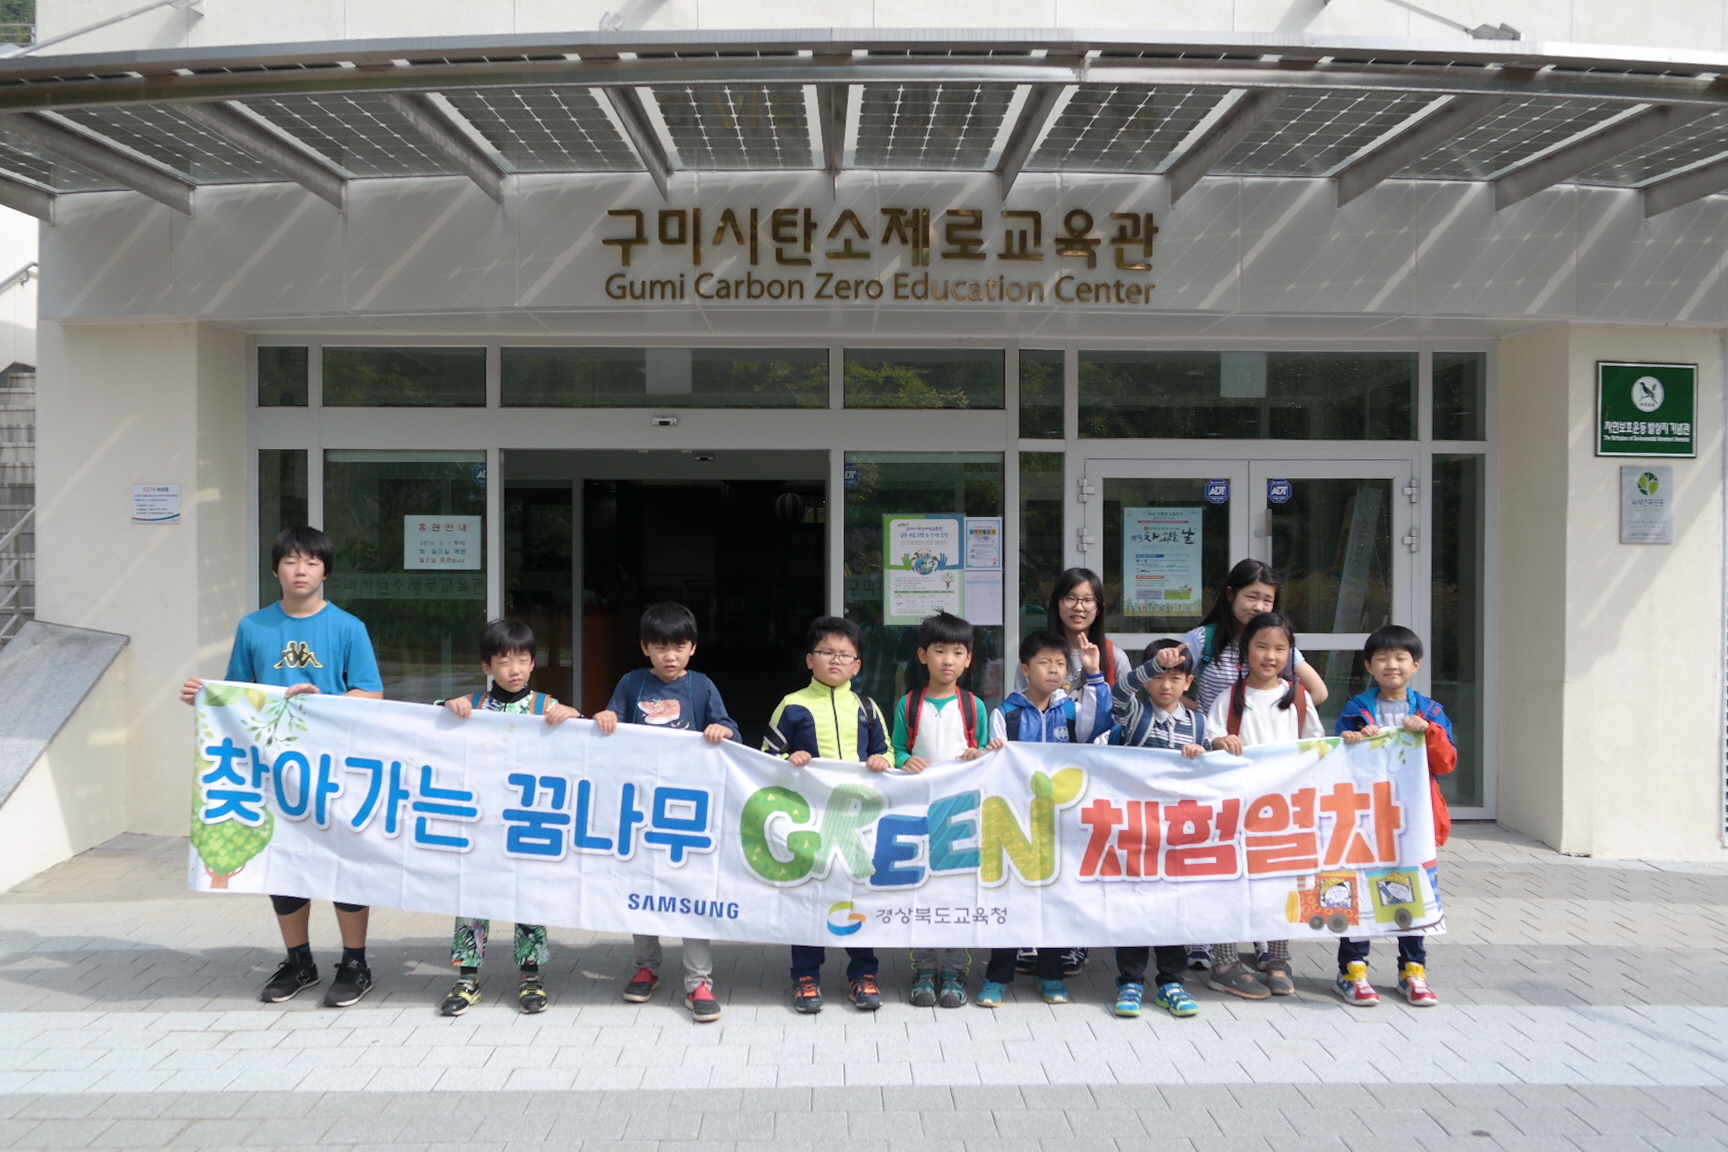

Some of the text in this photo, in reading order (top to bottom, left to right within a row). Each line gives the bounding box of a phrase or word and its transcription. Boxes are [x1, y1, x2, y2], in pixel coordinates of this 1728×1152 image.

[601, 207, 1159, 271] 구미시탄소제로교육관
[604, 271, 1156, 304] Gumi Carbon Zero Education Center
[1208, 486, 1226, 496] ADT
[1270, 486, 1288, 496] ADT
[202, 737, 713, 862] 찾아가는 꿈나무
[741, 770, 1070, 887] GREEN
[1079, 780, 1402, 877] 체험열차
[627, 893, 739, 919] SAMSUNG
[875, 906, 1008, 926] 경상북도교육청
